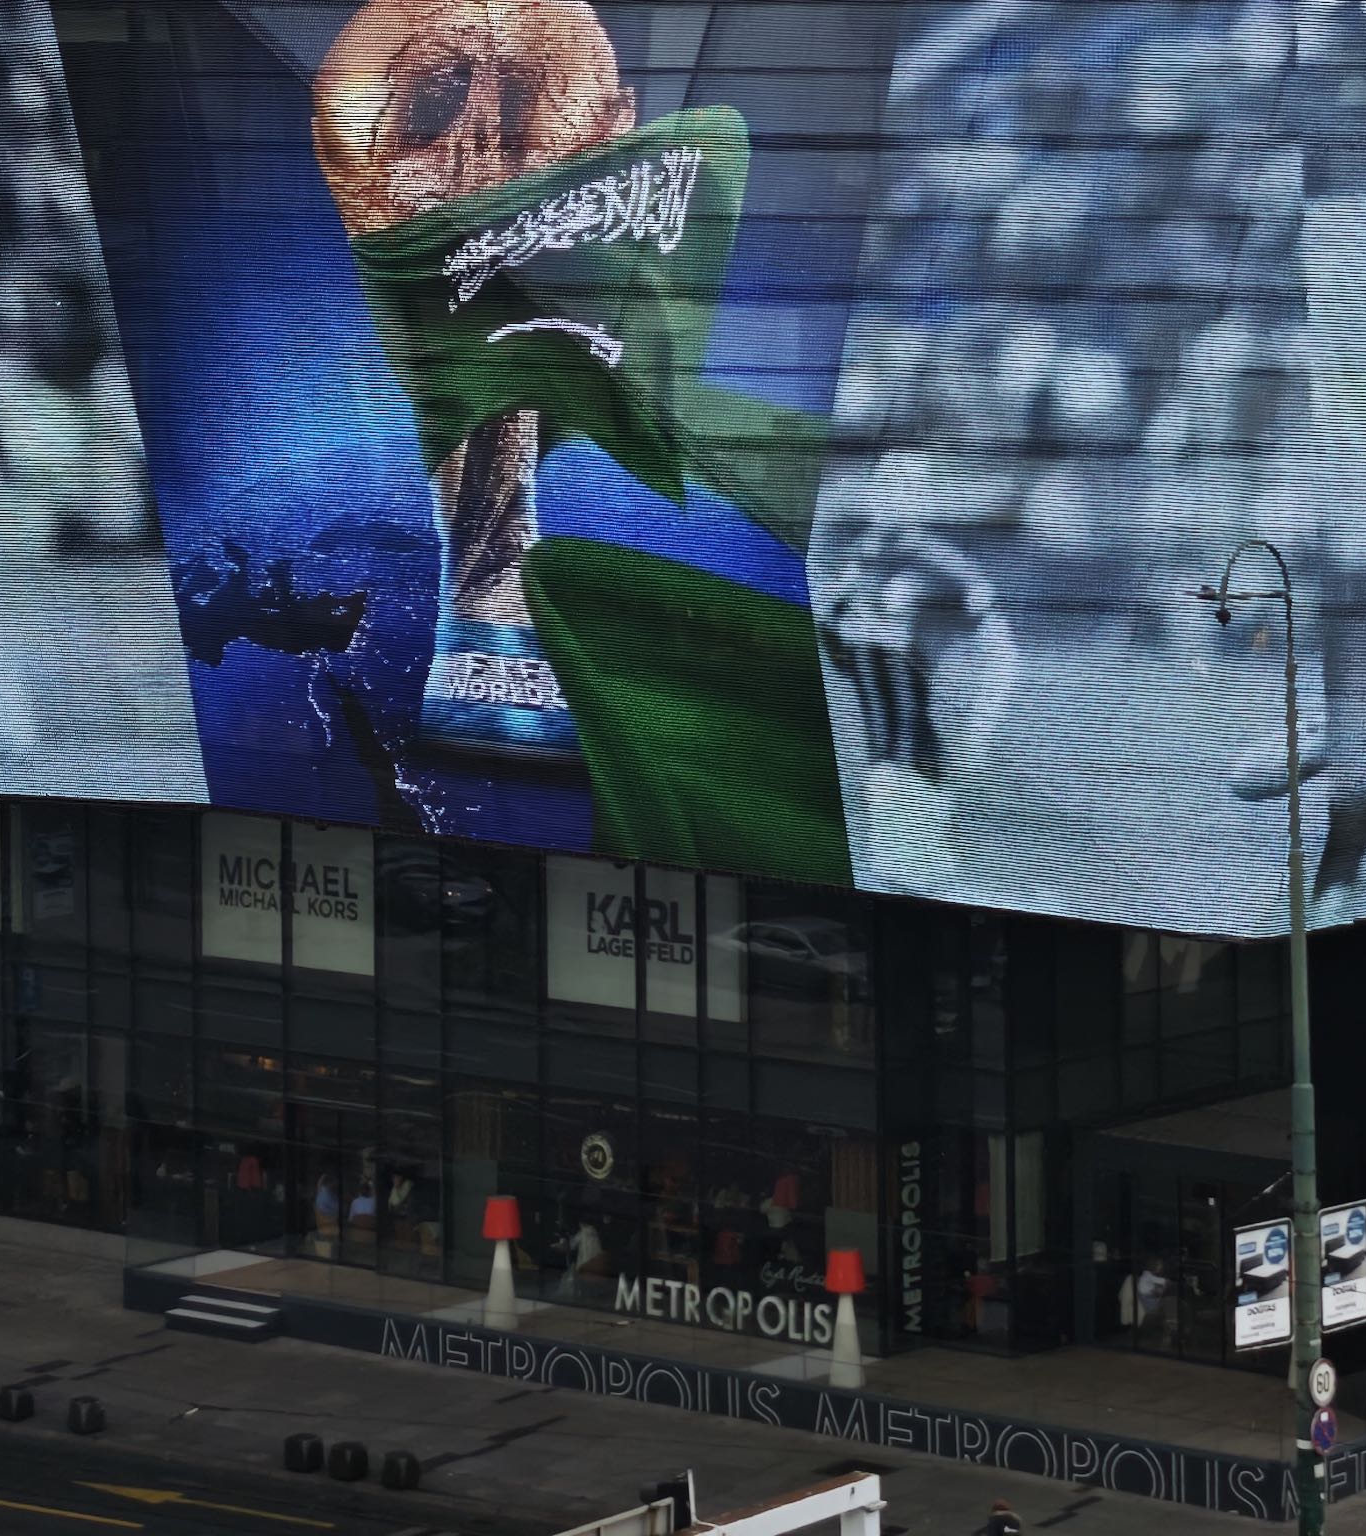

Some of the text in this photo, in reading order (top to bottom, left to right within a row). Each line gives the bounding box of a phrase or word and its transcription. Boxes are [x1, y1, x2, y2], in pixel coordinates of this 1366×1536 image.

[219, 887, 358, 921] MICHAL KORS
[587, 892, 693, 944] KARL
[587, 934, 693, 964] LAGEFELD
[901, 1141, 923, 1332] METROPOLIS
[614, 1271, 833, 1344] METROPOLIS
[381, 1317, 782, 1427] METROPOLIS
[1316, 1370, 1330, 1394] 60
[815, 1391, 1268, 1521] METROPOLIS
